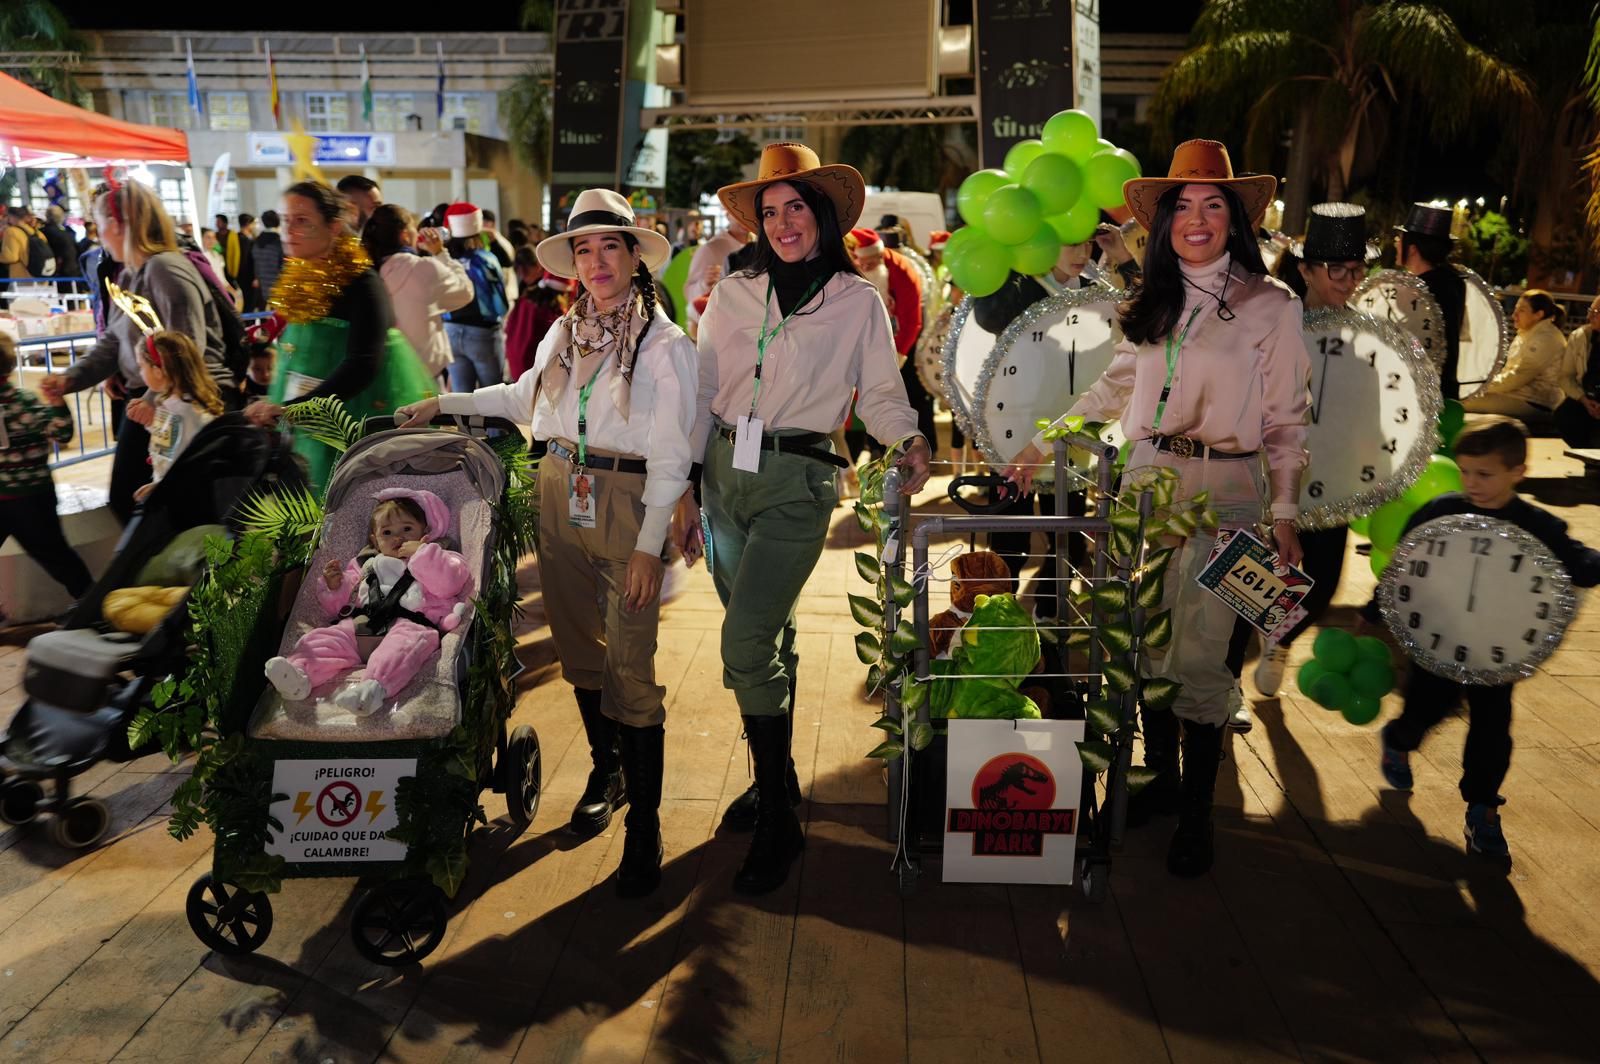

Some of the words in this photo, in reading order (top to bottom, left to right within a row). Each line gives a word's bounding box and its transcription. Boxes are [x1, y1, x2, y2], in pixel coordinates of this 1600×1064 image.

[993, 116, 1043, 137] tim
[1385, 288, 1397, 299] 12
[1411, 299, 1417, 311] 1
[1066, 315, 1079, 326] 12
[1107, 318, 1112, 328] 1
[1422, 319, 1430, 330] 2
[1032, 332, 1044, 341] 11
[1424, 338, 1431, 349] 3
[1317, 337, 1344, 355] 12
[1368, 351, 1376, 367] 1
[1003, 366, 1017, 376] 10
[1387, 372, 1401, 389] 2
[997, 402, 1004, 411] 9
[1394, 408, 1408, 423] 3
[1005, 429, 1013, 439] 8
[1107, 434, 1114, 442] 5
[1381, 439, 1396, 453] 4
[1360, 465, 1375, 482] 5
[1308, 481, 1324, 498] 6
[1426, 539, 1446, 556] 11
[1470, 537, 1492, 555] 12
[1408, 560, 1429, 577] 10
[1509, 554, 1523, 573] 1
[1231, 565, 1276, 599] 1197
[1530, 576, 1543, 593] 2
[1399, 585, 1411, 602] 9
[1536, 602, 1549, 619] 3
[1409, 612, 1421, 629] 8
[1430, 633, 1441, 649] 7
[1522, 628, 1537, 644] 4
[1454, 645, 1468, 662] 6
[1491, 646, 1504, 663] 5
[315, 767, 375, 780] ¡PELIGRO!
[290, 831, 338, 843] ¡CUIDAO
[342, 831, 366, 842] QUE
[369, 831, 385, 840] DA
[983, 832, 1035, 852] PARK
[304, 848, 369, 857] CALAMBRE!
